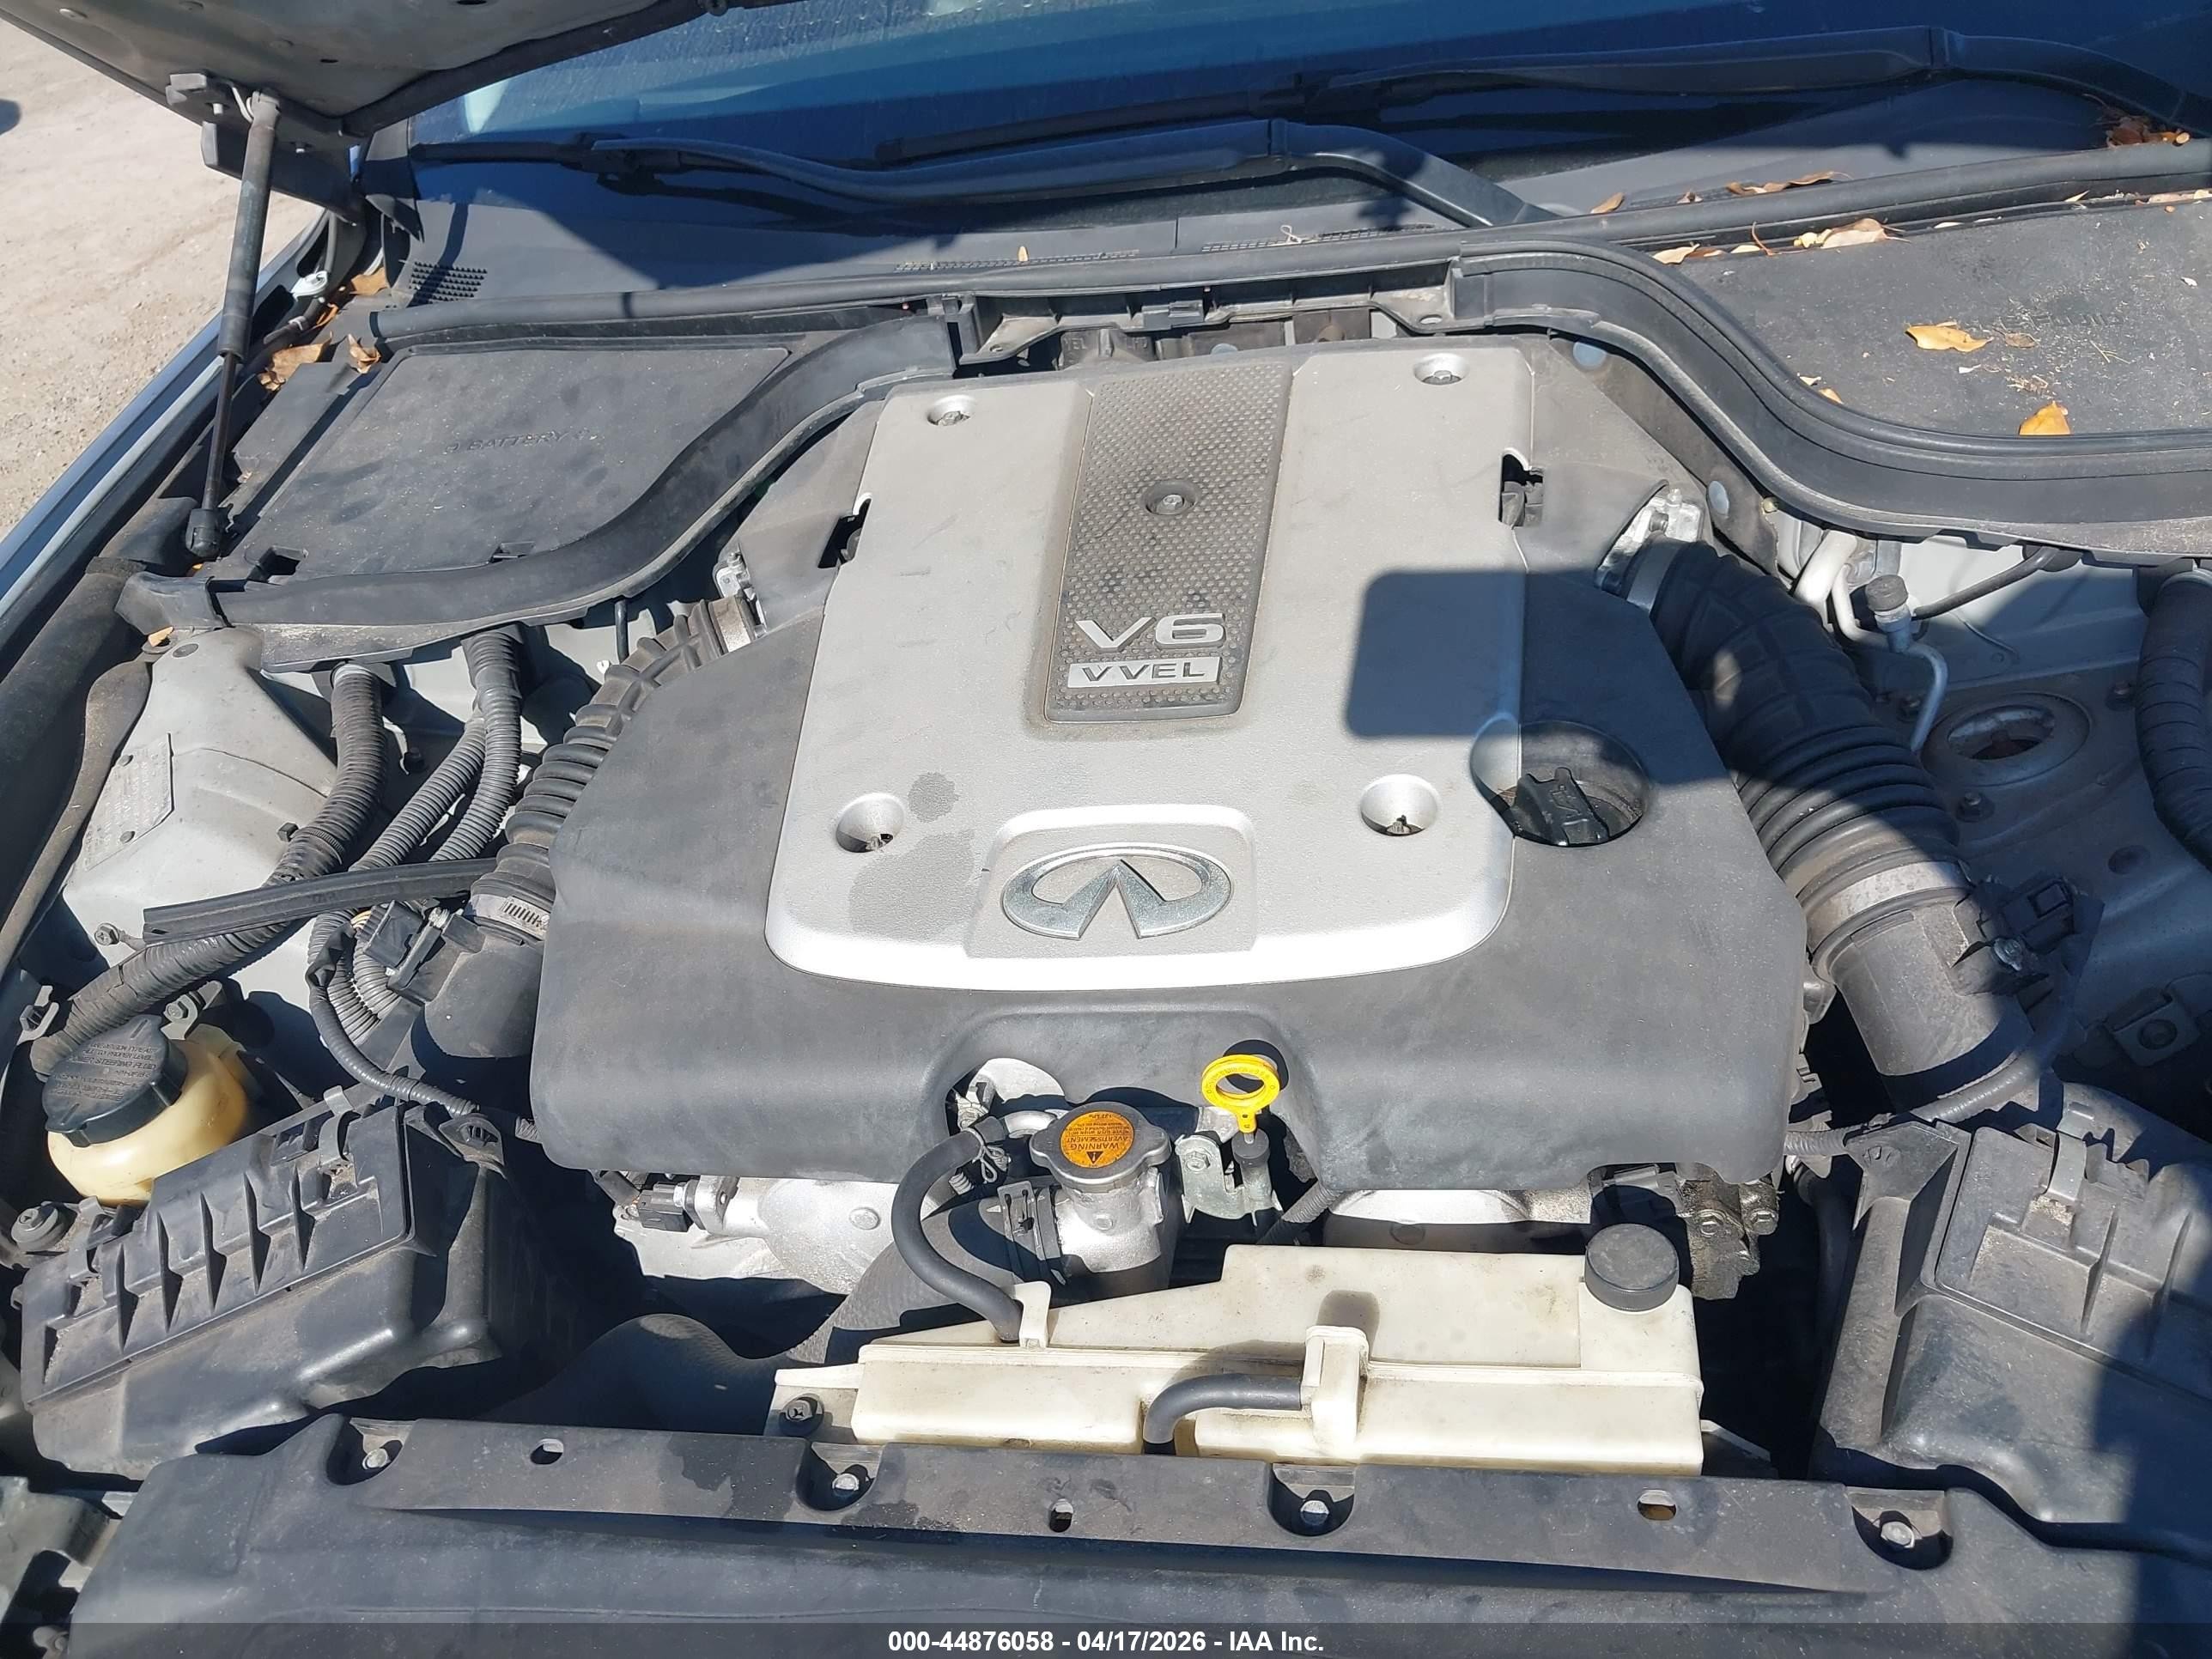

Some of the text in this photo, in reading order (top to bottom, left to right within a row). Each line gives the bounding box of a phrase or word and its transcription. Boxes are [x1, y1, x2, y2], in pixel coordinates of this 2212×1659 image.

[467, 431, 570, 452] BATTERY
[1075, 612, 1226, 652] V6
[1081, 661, 1206, 682] VVEL
